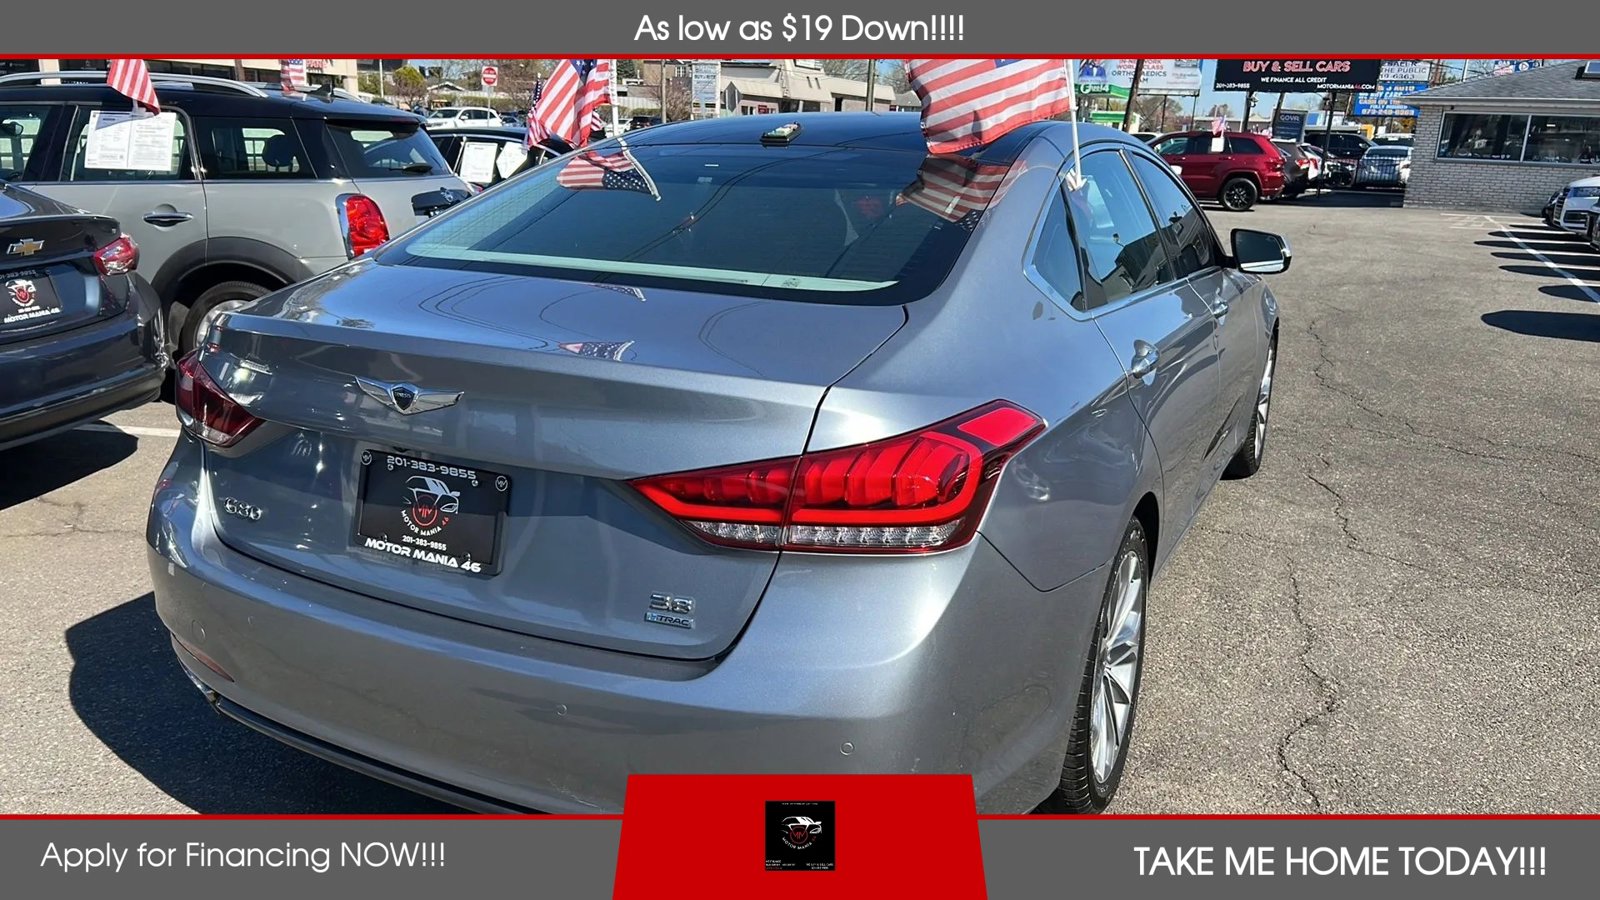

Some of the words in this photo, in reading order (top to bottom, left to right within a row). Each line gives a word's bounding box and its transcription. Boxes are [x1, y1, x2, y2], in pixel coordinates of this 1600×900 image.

[1243, 61, 1266, 72] BUY
[1271, 61, 1281, 72] &
[1284, 61, 1312, 72] SELL
[1315, 61, 1351, 72] CARS
[386, 455, 477, 481] 201-383-9855
[401, 509, 419, 534] MOTOR
[420, 526, 442, 536] MANIA
[364, 537, 411, 557] MOTOR
[413, 549, 459, 568] MANIA
[460, 560, 482, 573] 46
[402, 534, 447, 551] 201-383-9855
